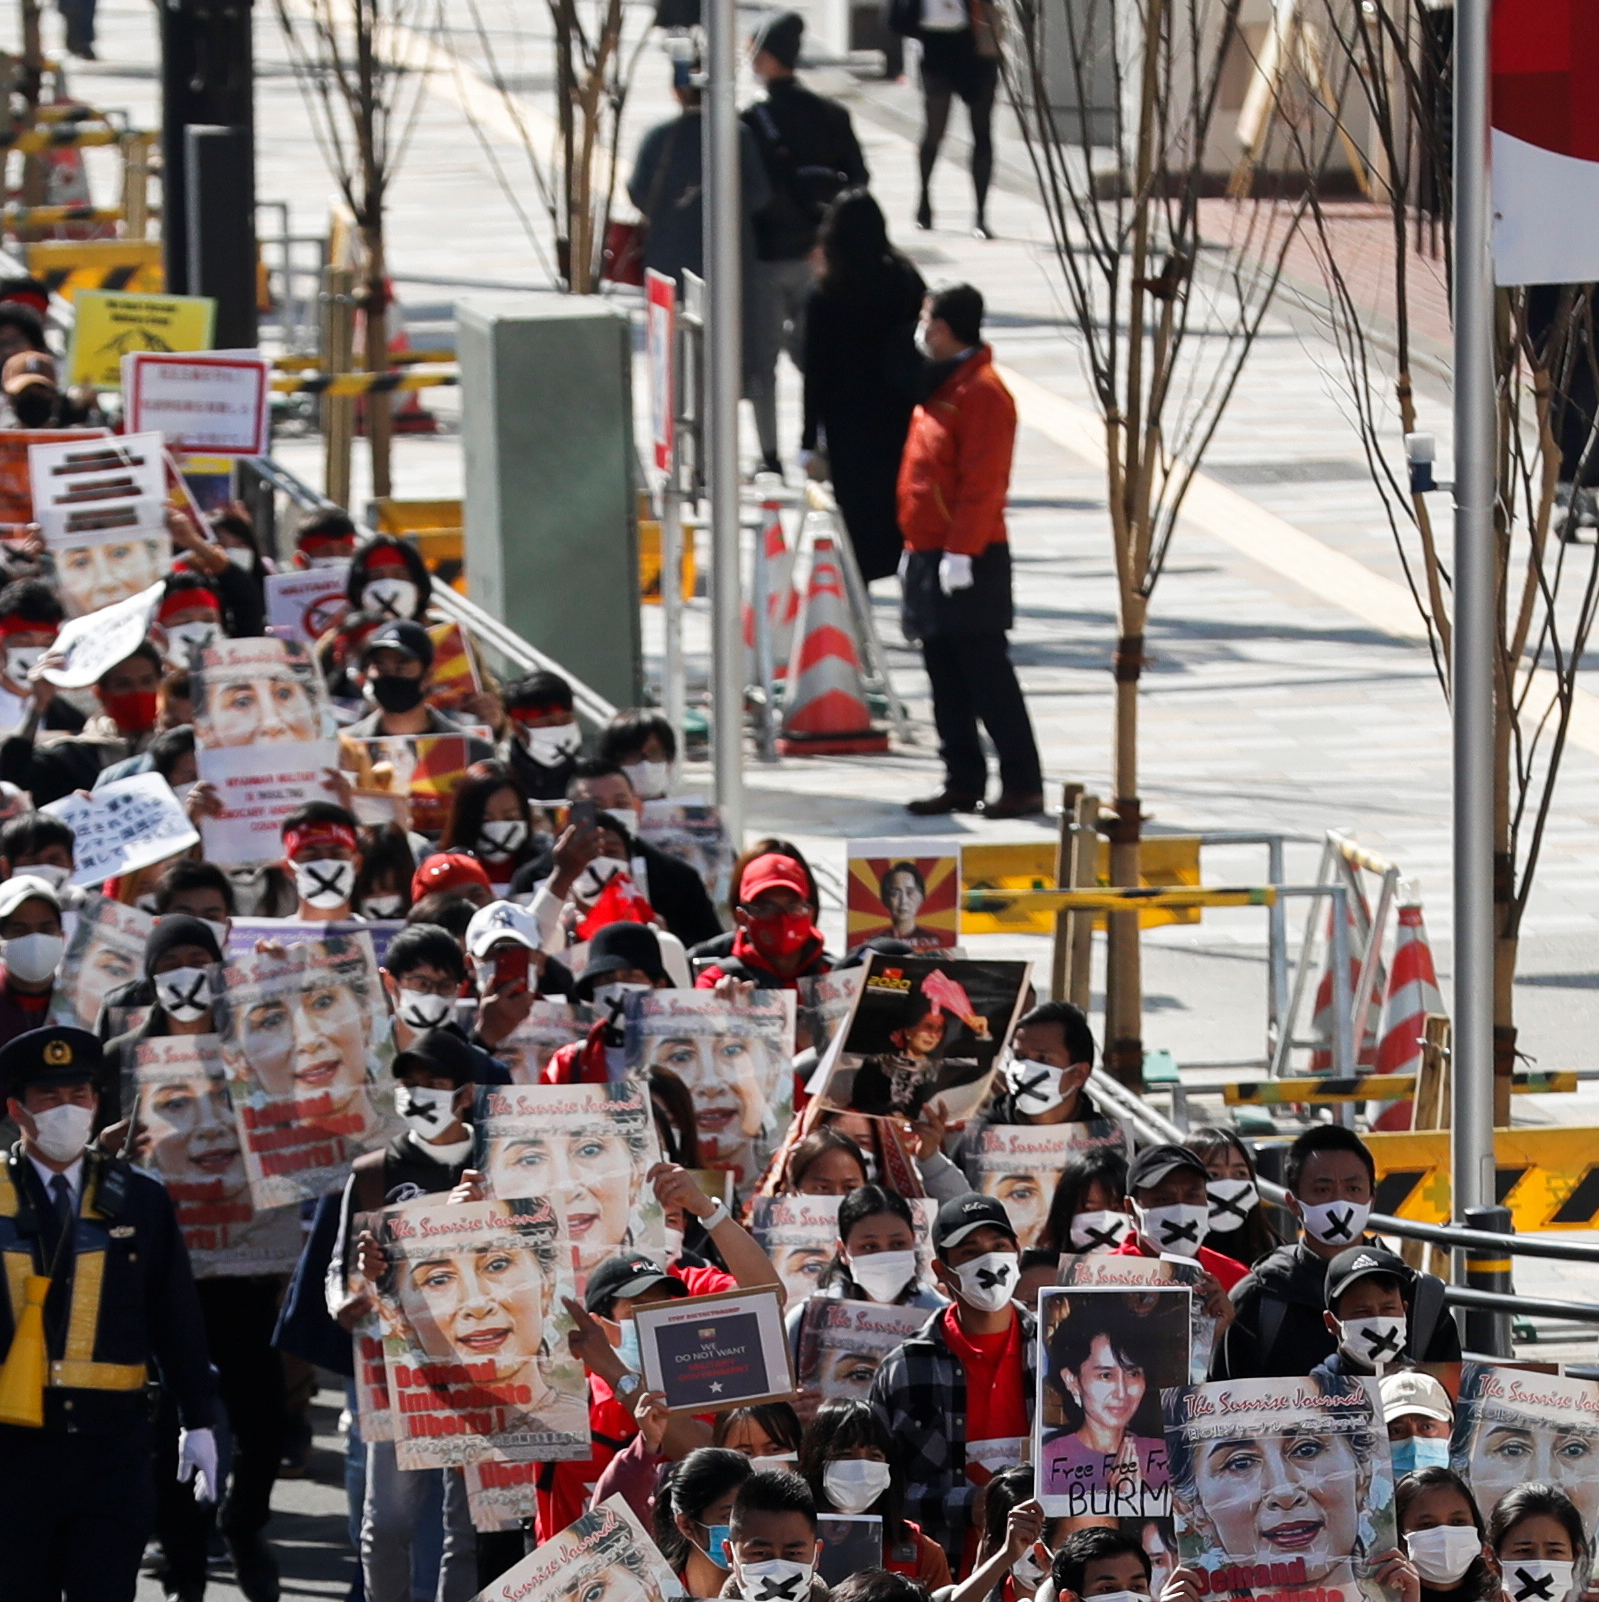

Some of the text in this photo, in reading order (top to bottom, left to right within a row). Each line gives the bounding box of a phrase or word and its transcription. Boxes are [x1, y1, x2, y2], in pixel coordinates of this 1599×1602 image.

[867, 975, 912, 990] 2020
[674, 1345, 747, 1364] DO NOT WANT
[700, 1341, 717, 1353] WE
[1183, 1386, 1364, 1418] The Sunrise Journal
[1479, 1374, 1504, 1398] The
[1509, 1380, 1572, 1408] Sunrise
[1051, 1449, 1169, 1480] Free Free Fr
[1068, 1478, 1173, 1518] BURM
[502, 1561, 559, 1601] Sunrise
[559, 1509, 620, 1564] Journal
[1192, 1557, 1307, 1597] Demand
